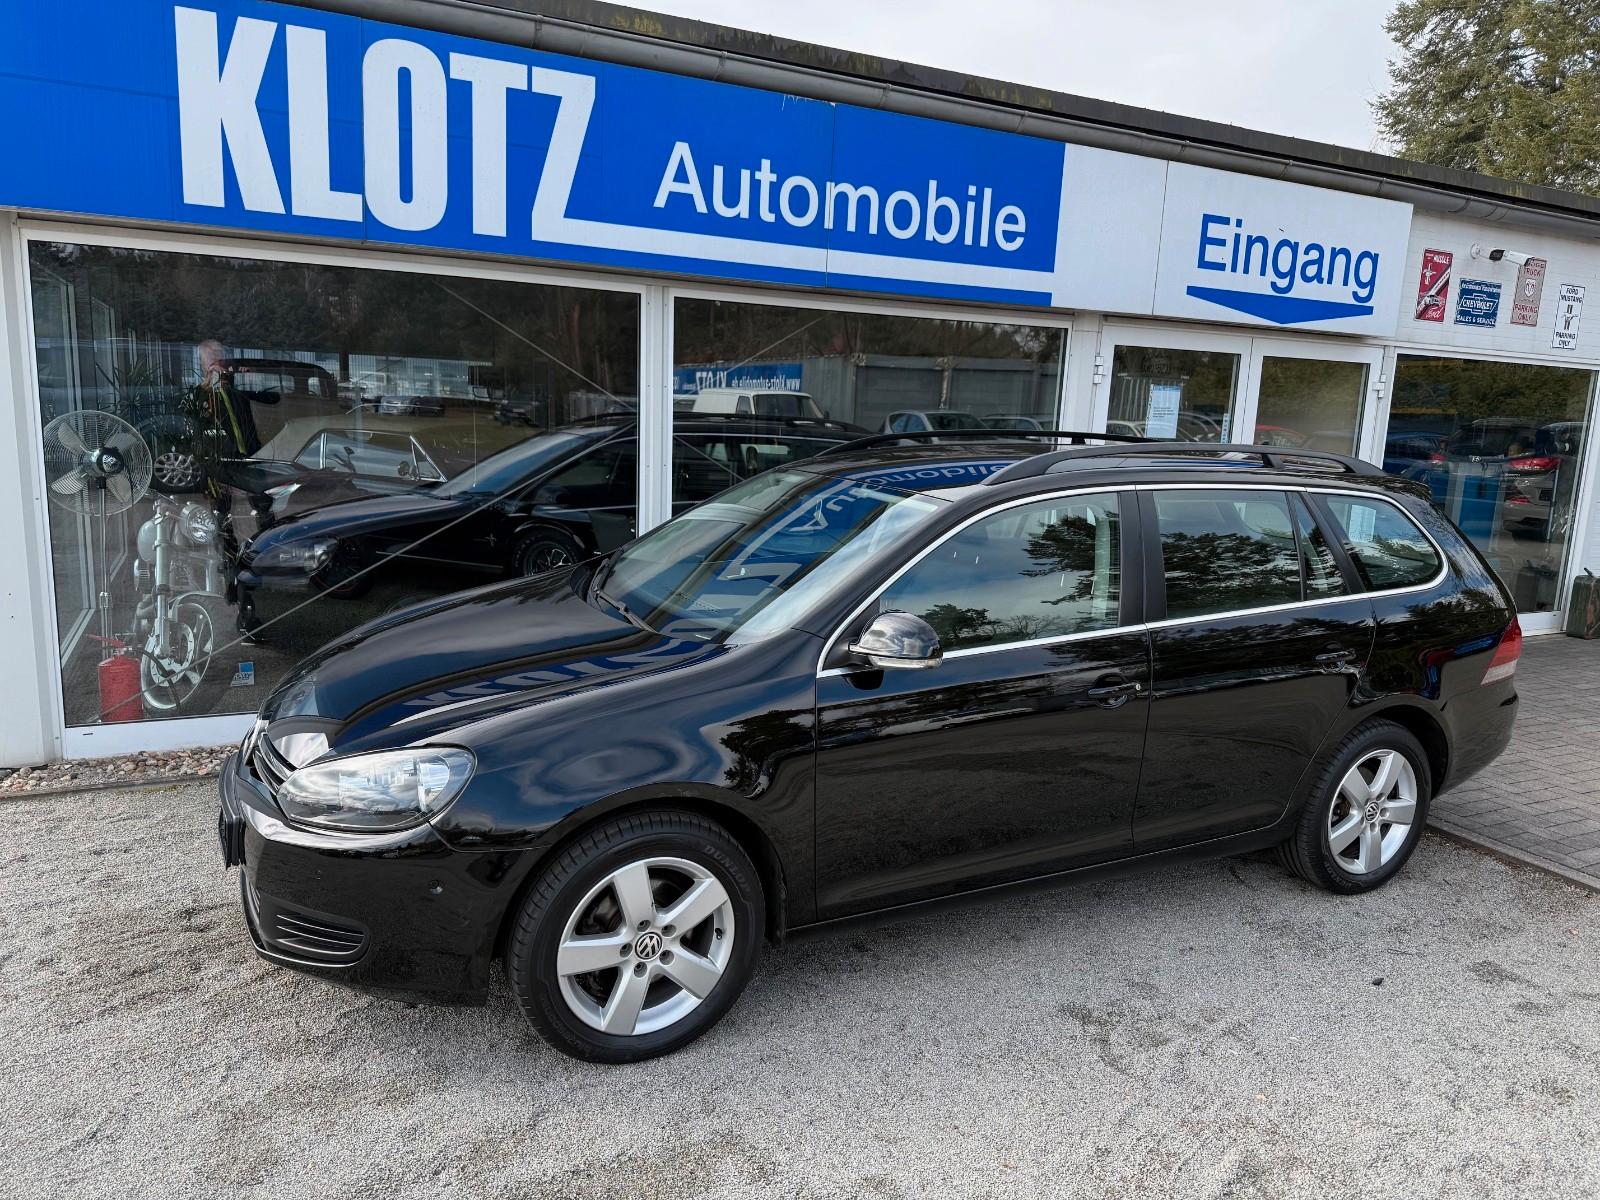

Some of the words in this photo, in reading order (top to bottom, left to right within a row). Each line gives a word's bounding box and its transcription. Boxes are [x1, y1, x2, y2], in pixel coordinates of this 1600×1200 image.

[174, 6, 596, 241] KLOTZ
[654, 141, 1027, 252] Automobile
[1198, 214, 1379, 304] Eingang
[1566, 287, 1579, 296] FORD
[1561, 294, 1583, 304] MUSTANG
[1462, 299, 1494, 311] CHEVROLET
[1515, 303, 1538, 314] PARKING
[1456, 315, 1472, 323] SALES
[1477, 317, 1496, 326] SERVICE
[1556, 331, 1576, 340] PARKING
[703, 843, 750, 894] DUNLOP
